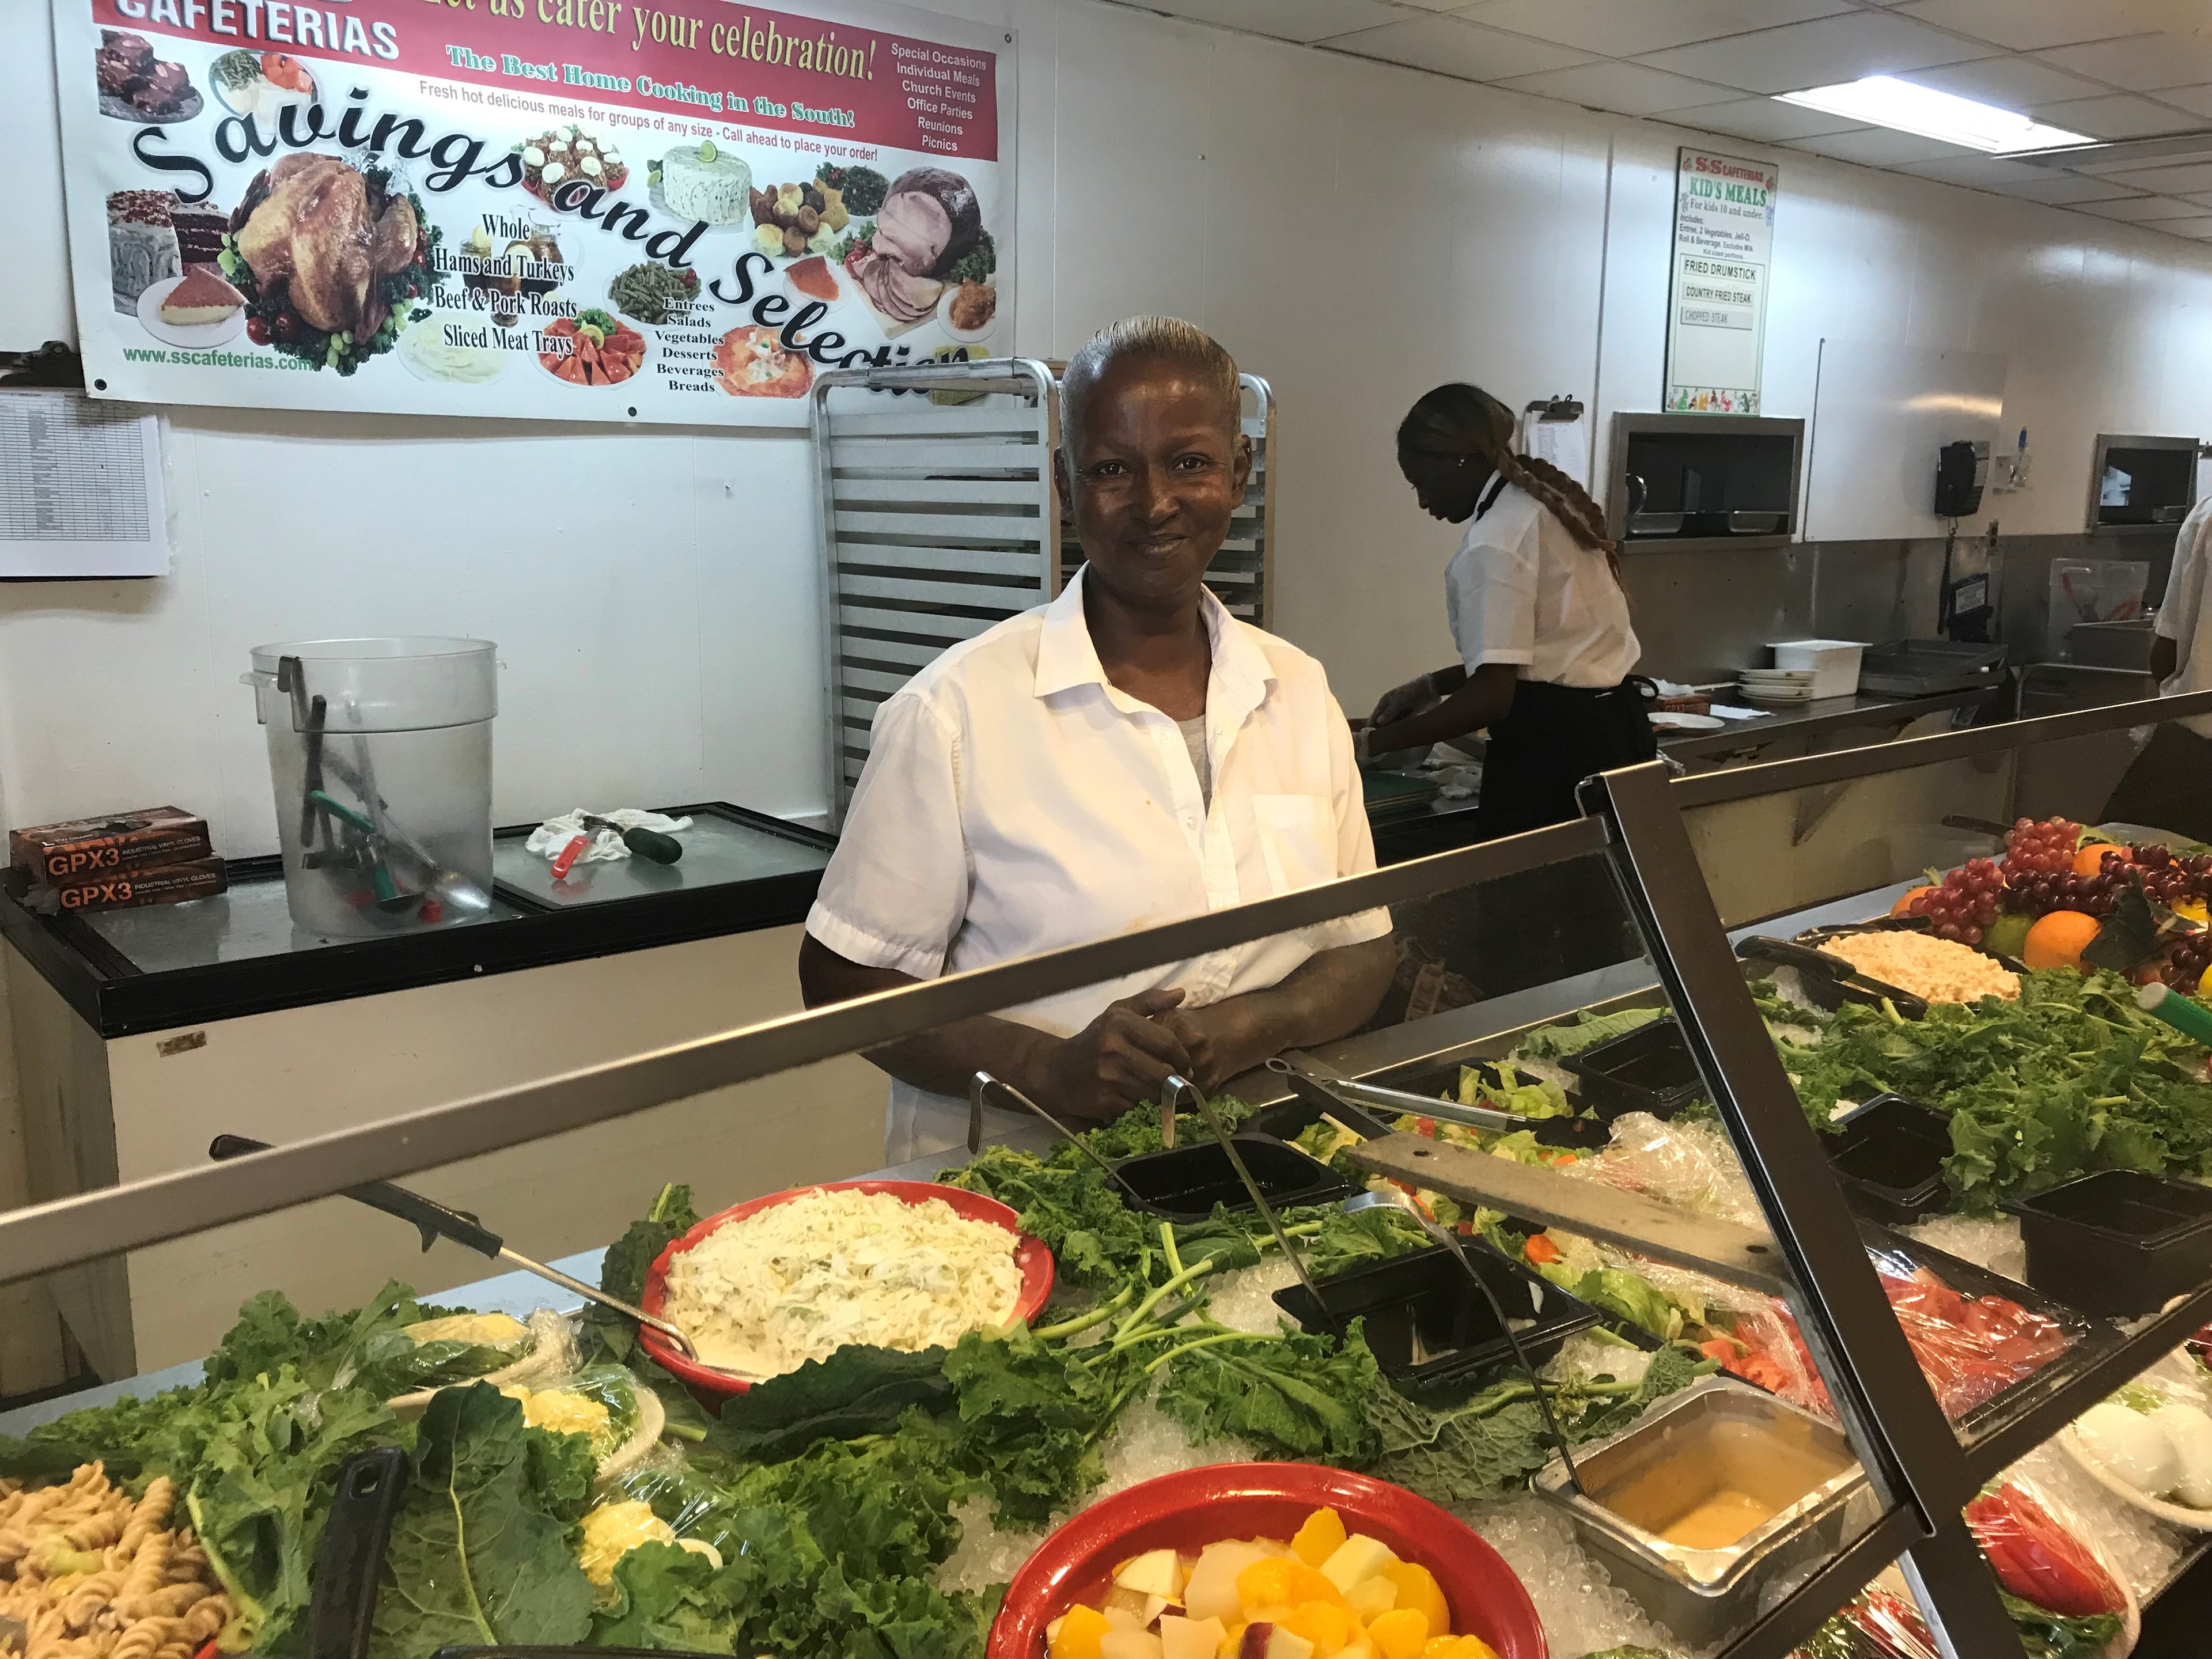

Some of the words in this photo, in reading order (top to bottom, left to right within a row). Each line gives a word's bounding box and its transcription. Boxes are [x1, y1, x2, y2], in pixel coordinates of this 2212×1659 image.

[117, 0, 400, 60] CAFETERIAS
[538, 0, 622, 34] cater
[631, 7, 703, 51] your
[711, 16, 876, 81] celebration!
[891, 43, 929, 61] Special
[933, 51, 987, 71] Occasions
[897, 62, 950, 80] Individual
[953, 70, 980, 86] Meals
[445, 44, 497, 72] The
[501, 54, 558, 82] Best
[563, 63, 632, 92] Home
[637, 75, 723, 112] Cooking
[727, 92, 749, 113] in
[753, 96, 787, 118] the
[791, 101, 855, 128] South!
[902, 80, 942, 96] Church
[945, 86, 976, 103] Events
[907, 97, 938, 113] Office
[941, 103, 973, 120] Parties
[419, 81, 457, 100] Fresh
[462, 87, 483, 104] hot
[487, 92, 544, 113] delicious
[549, 104, 585, 119] meals
[588, 107, 605, 122] for
[609, 113, 650, 130] groups
[654, 118, 665, 130] of
[668, 123, 687, 137] any
[691, 124, 713, 137] size
[722, 127, 743, 142] Call
[746, 131, 778, 147] ahead
[780, 137, 791, 149] to
[794, 139, 821, 153] place
[824, 145, 847, 157] your
[850, 147, 877, 161] order!
[918, 116, 963, 135] Reunions
[922, 135, 958, 151] Picnics
[133, 86, 525, 204] Savings
[554, 179, 709, 268] and
[1690, 177, 1722, 200] KID'S
[1725, 183, 1766, 207] MEALS
[1690, 198, 1703, 209] For
[1704, 200, 1718, 213] kids
[1720, 204, 1728, 214] 10
[1729, 206, 1741, 215] and
[482, 214, 530, 240] Whole
[434, 248, 480, 275] Hams
[484, 254, 512, 276] and
[516, 255, 574, 286] Turkeys
[1685, 260, 1708, 273] FRIED
[1711, 264, 1756, 280] DRUMSTICK
[434, 286, 468, 310] Beef
[472, 289, 485, 311] &
[490, 290, 526, 315] Pork
[531, 293, 577, 317] Roasts
[664, 298, 714, 312] Entrees
[1686, 286, 1714, 299] COUNTRY
[1715, 290, 1732, 301] FRIED
[1733, 292, 1751, 304] STEAK
[668, 315, 711, 328] Salads
[1685, 310, 1709, 322] CHOPPED
[1711, 313, 1728, 323] STEAK
[444, 324, 488, 349] Sliced
[491, 327, 529, 351] Meat
[532, 331, 572, 359] Trays
[654, 330, 724, 344] Vegetables
[123, 348, 313, 371] www.sscafeterias.com
[662, 347, 717, 361] Desserts
[657, 363, 724, 378] Beverages
[669, 380, 715, 392] Breads
[48, 848, 119, 876] GPX3
[122, 844, 158, 855] INDUSTRIAL
[176, 836, 200, 844] GLOVES
[61, 882, 132, 908] GPX3
[134, 880, 171, 890] INDUSTRIAL
[191, 873, 216, 881] GLOVES
